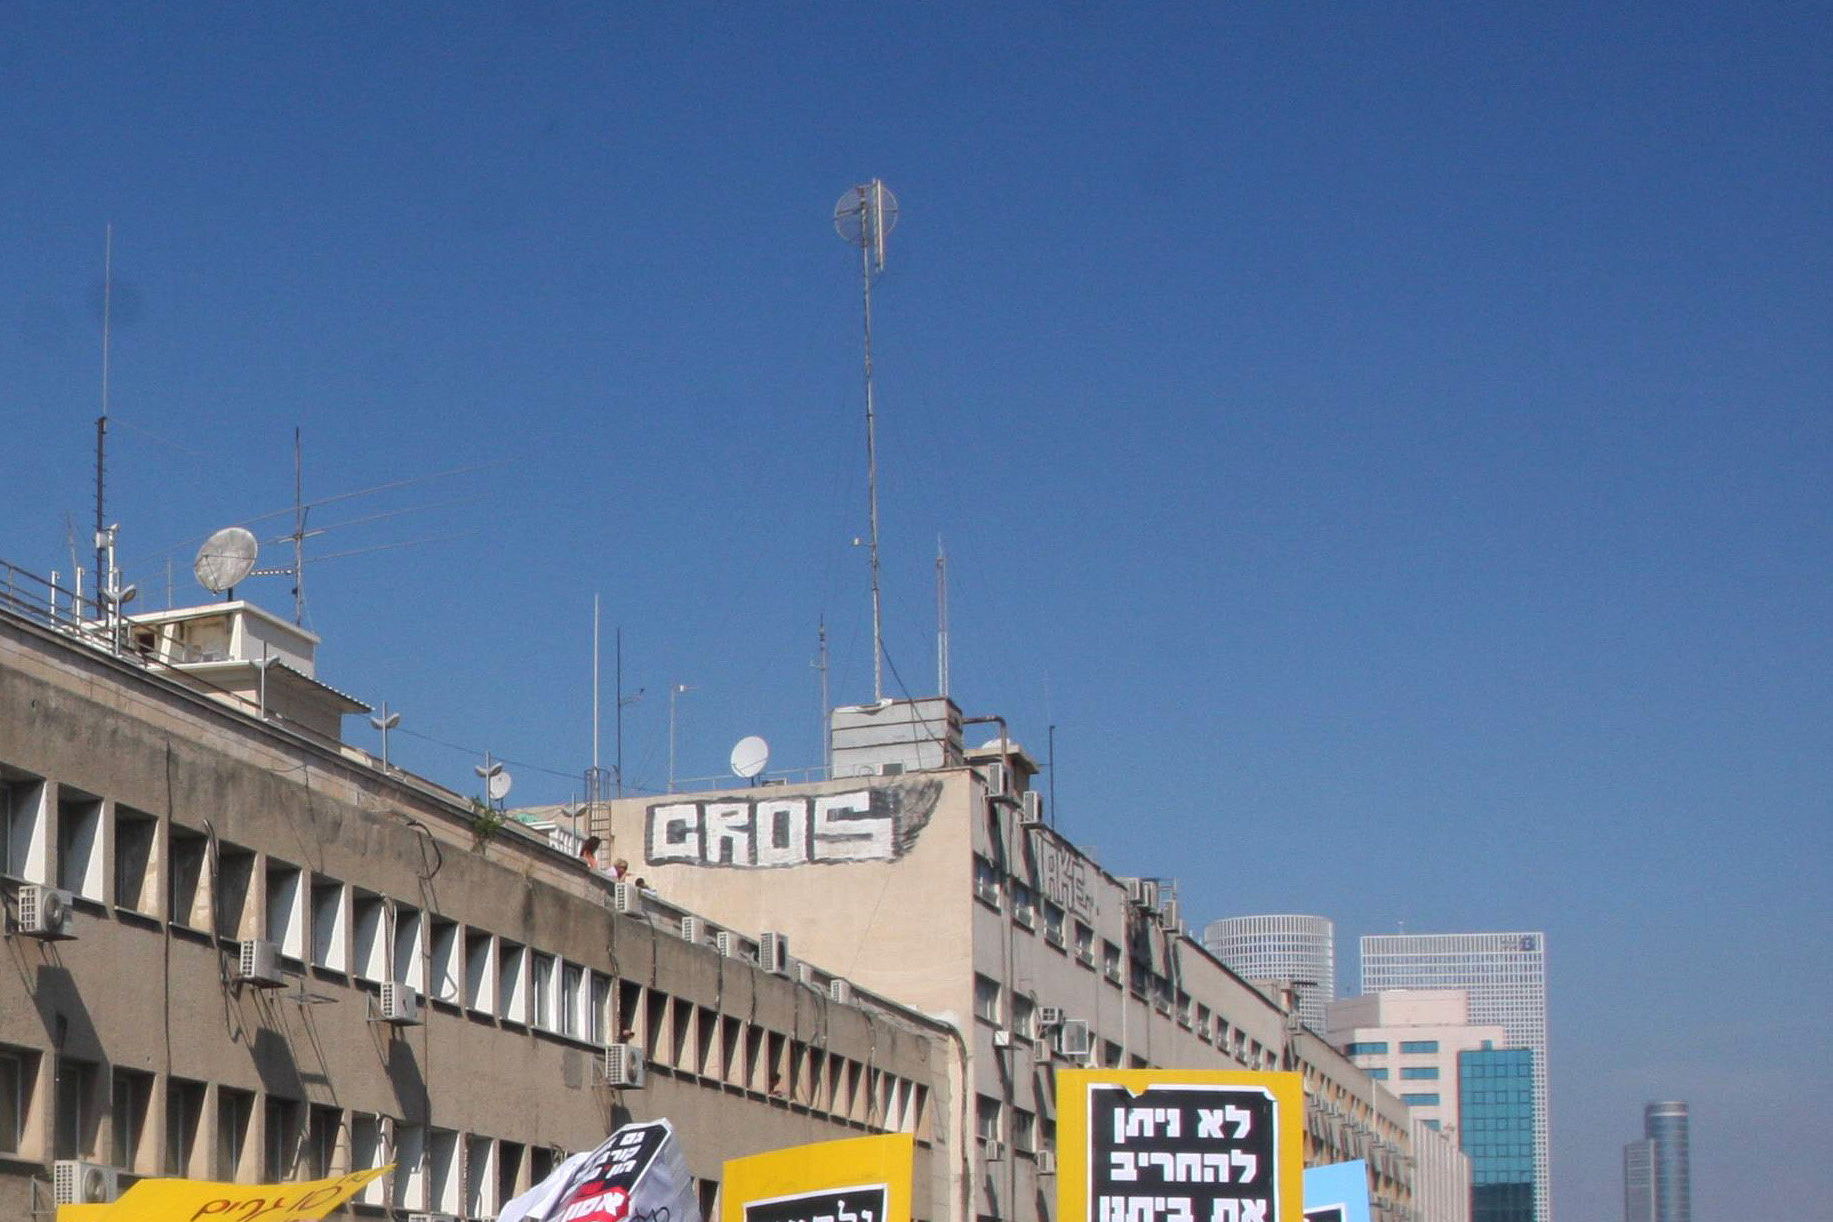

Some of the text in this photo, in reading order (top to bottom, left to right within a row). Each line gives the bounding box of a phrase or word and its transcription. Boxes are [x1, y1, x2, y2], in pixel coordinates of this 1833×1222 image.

[647, 790, 896, 868] CROS
[1113, 1104, 1252, 1144] לא ניתן
[1109, 1149, 1257, 1183] להחריב
